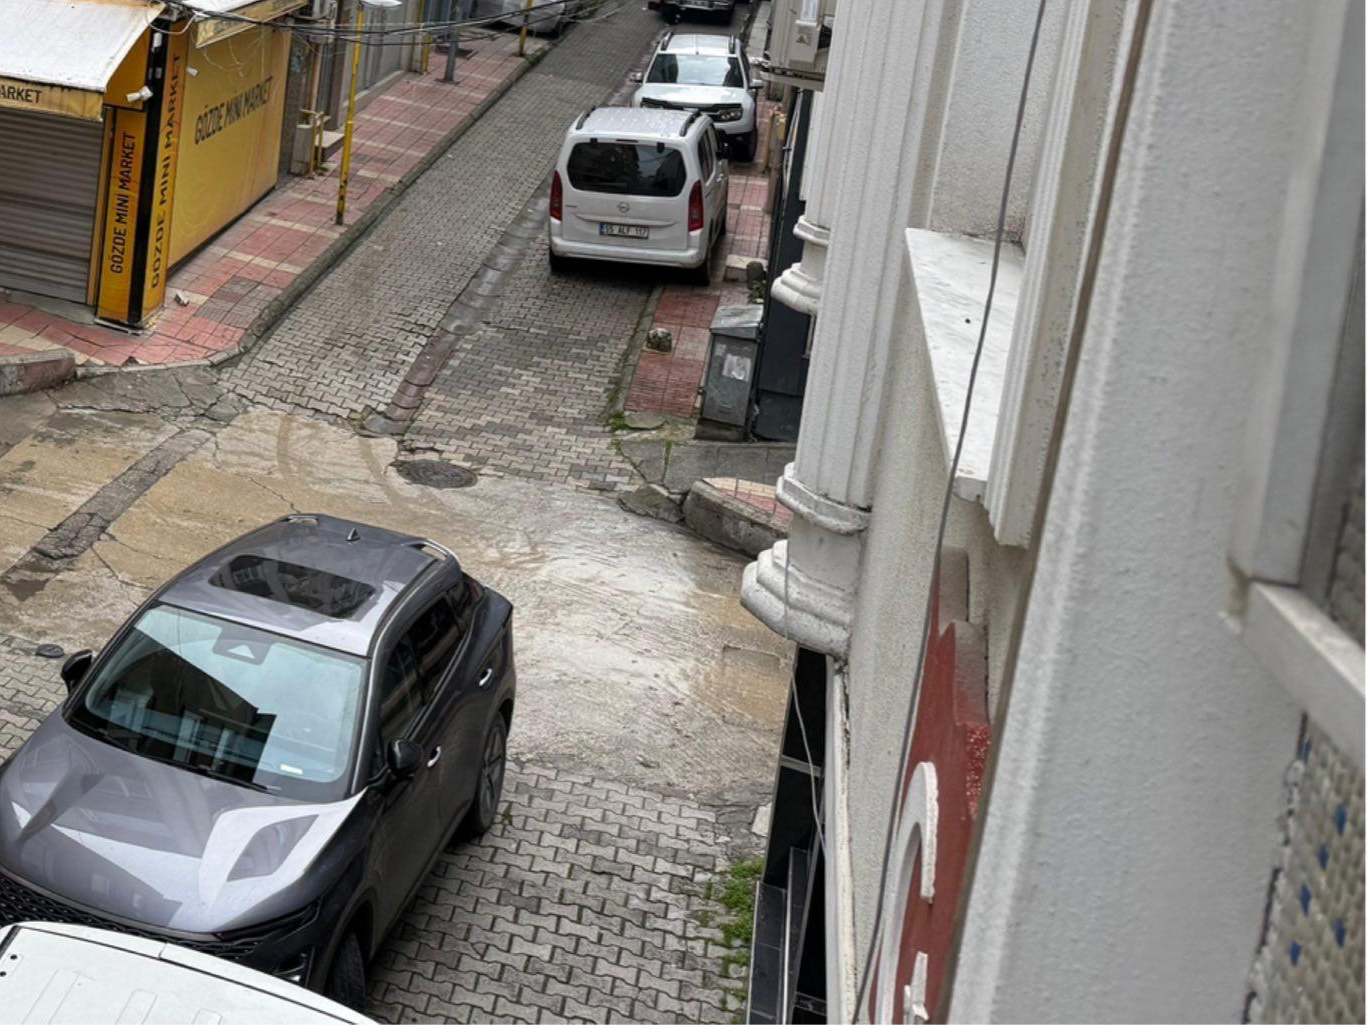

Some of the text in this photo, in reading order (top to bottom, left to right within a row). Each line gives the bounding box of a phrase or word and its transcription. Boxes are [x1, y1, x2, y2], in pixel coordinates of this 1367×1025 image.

[150, 209, 165, 288] GÖZDE
[164, 54, 180, 148] MARKET
[195, 102, 225, 144] GÖZDE
[243, 76, 273, 118] MARKET
[109, 132, 136, 274] GÖZDE MİNİ MARKET
